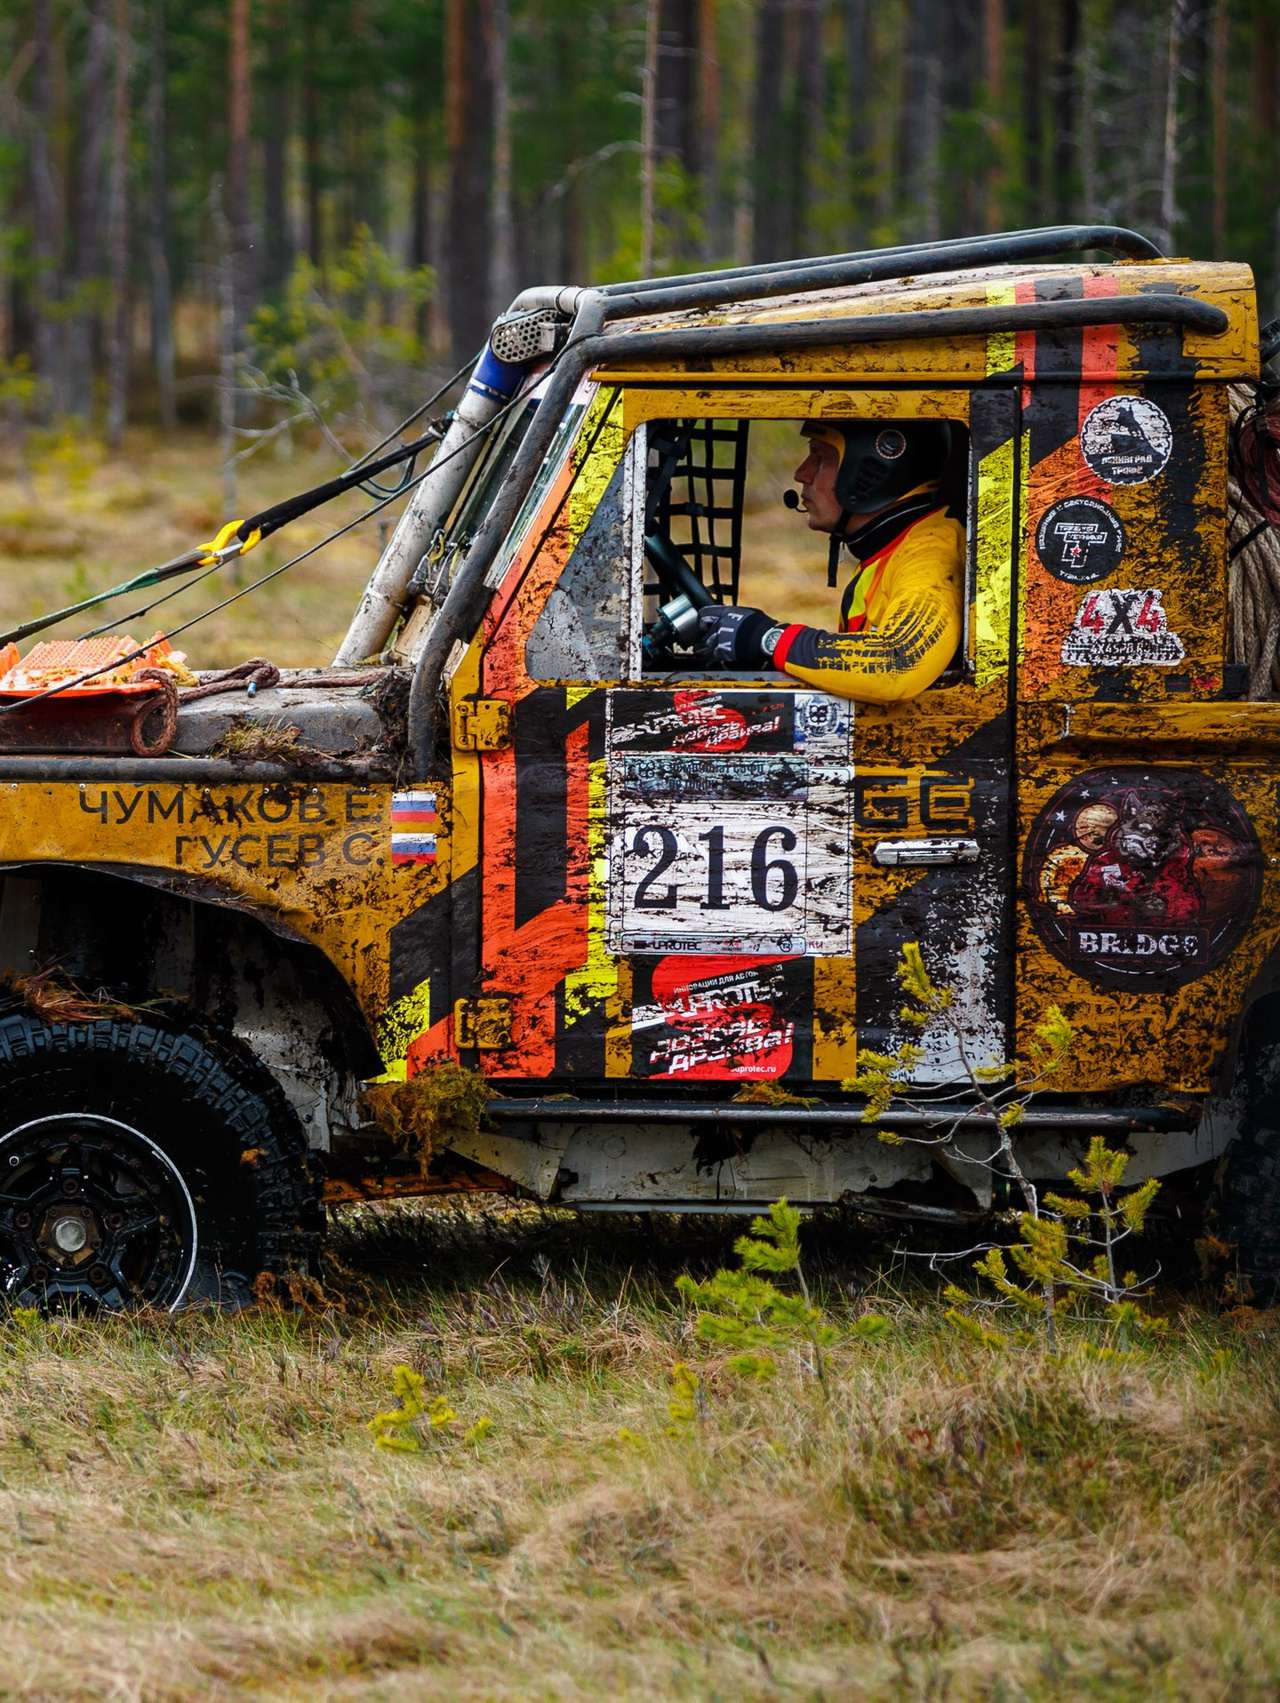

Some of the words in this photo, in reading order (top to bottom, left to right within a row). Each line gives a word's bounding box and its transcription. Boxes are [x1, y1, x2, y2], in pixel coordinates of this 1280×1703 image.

[79, 789, 327, 825] ЧУМАКОВ
[175, 833, 326, 869] ГУСЕВ
[343, 832, 385, 866] С.
[632, 825, 799, 912] 216
